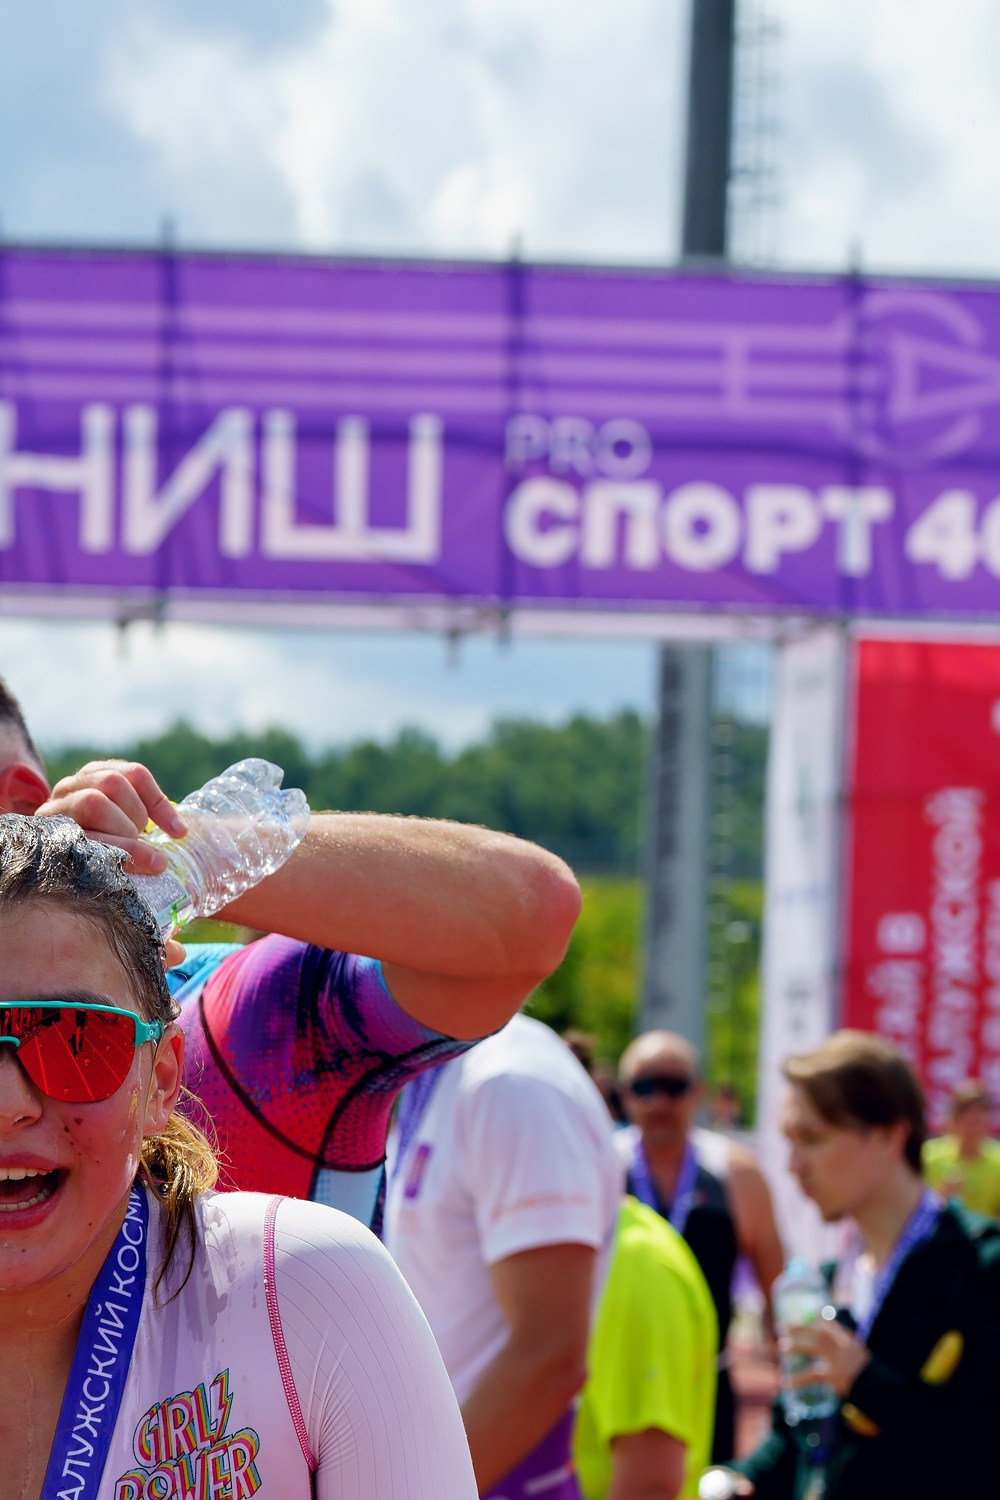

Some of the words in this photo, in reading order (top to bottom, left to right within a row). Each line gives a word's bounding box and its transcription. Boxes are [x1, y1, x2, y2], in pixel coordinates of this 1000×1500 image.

[504, 411, 654, 484] PRO
[503, 474, 896, 578] СПОРТ
[905, 486, 1000, 582] 4
